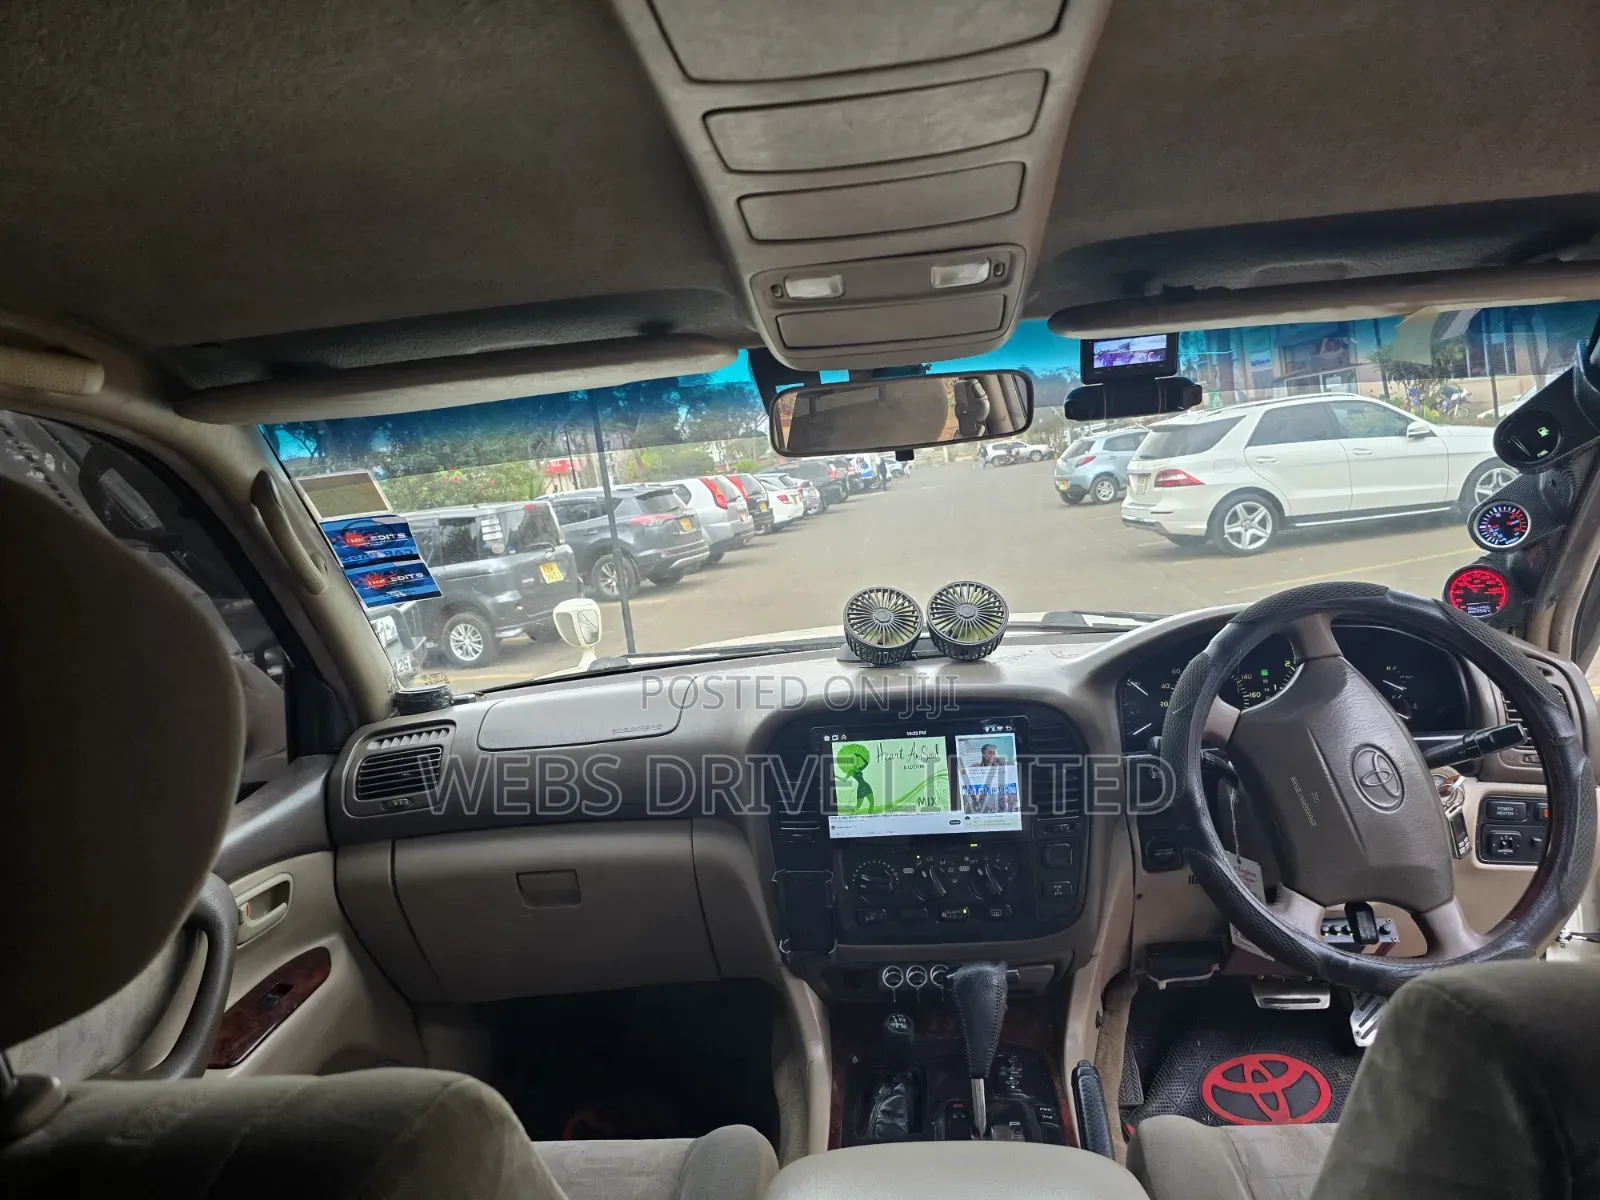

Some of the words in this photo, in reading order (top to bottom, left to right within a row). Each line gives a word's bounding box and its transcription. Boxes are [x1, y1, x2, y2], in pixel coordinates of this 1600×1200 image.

[369, 532, 407, 541] EDITS
[1161, 682, 1171, 690] 40
[877, 742, 905, 763] Heart
[917, 796, 938, 807] MIX
